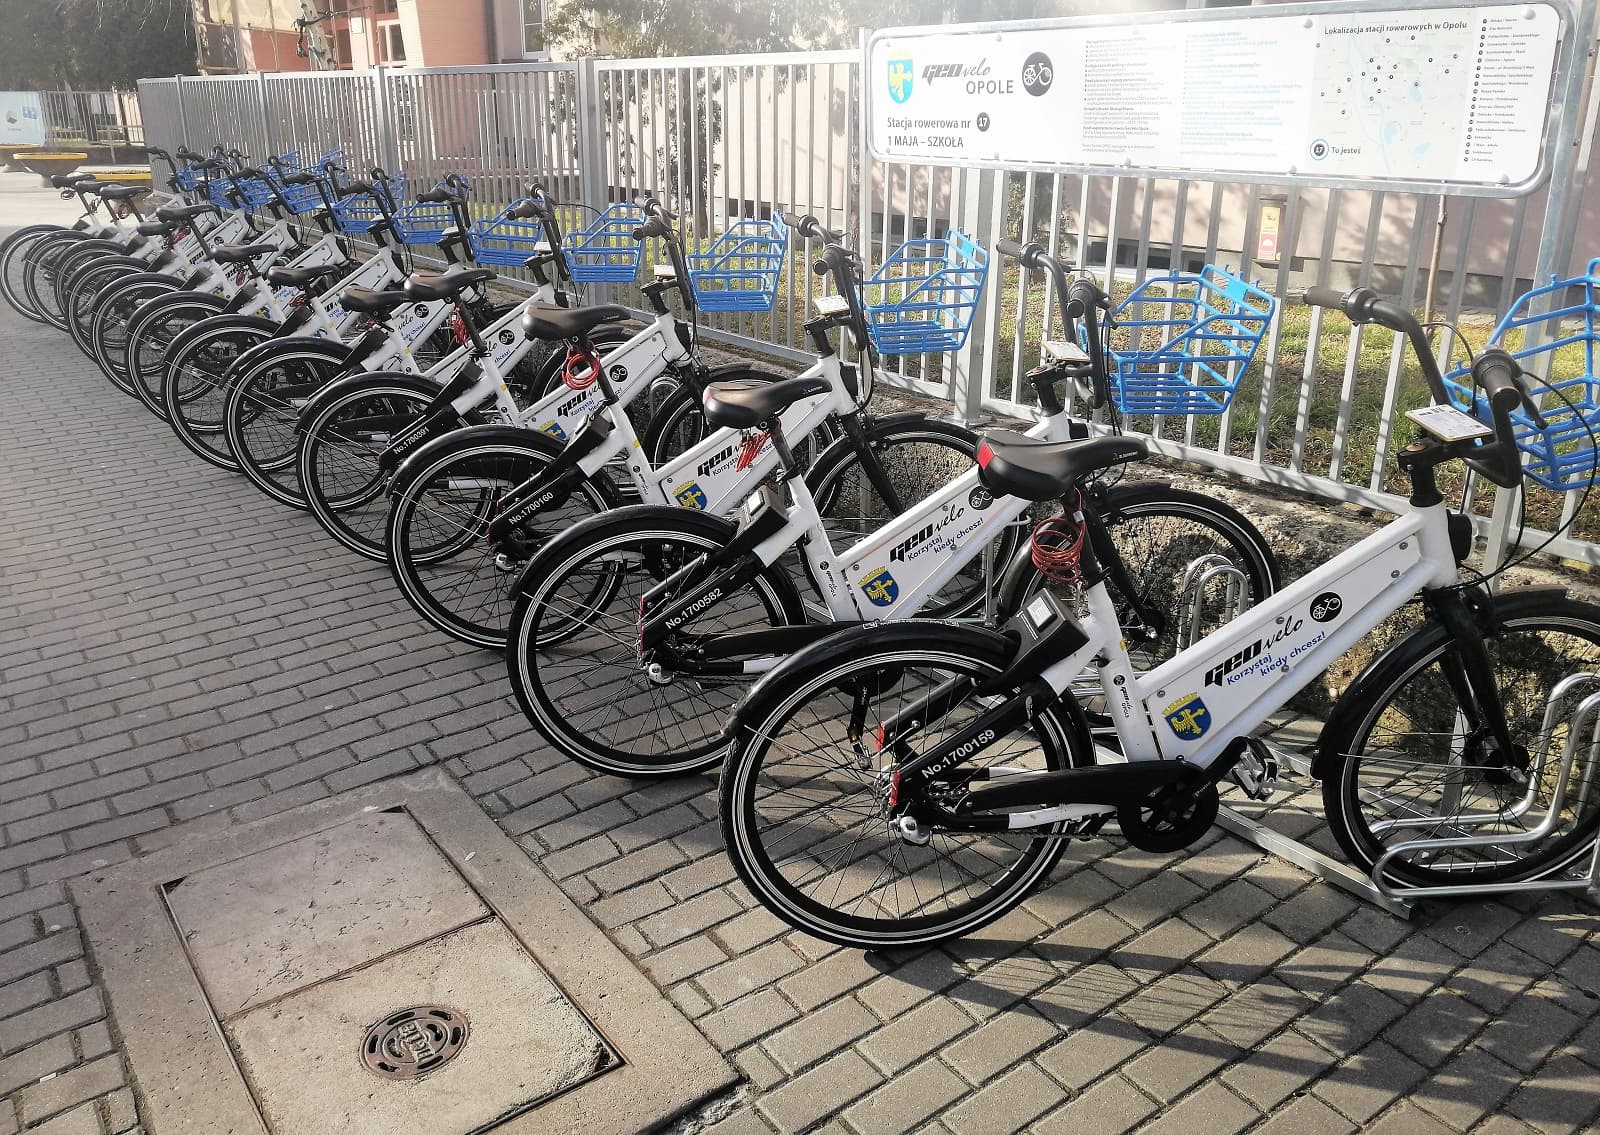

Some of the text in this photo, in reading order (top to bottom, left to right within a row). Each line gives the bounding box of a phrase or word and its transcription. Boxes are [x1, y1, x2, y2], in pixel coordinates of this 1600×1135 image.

[1324, 25, 1364, 35] Lokalizacja
[1365, 24, 1385, 34] stacji
[1386, 22, 1432, 32] rowerowych
[1443, 20, 1468, 31] Opolu
[965, 79, 1014, 95] OPOLE
[887, 116, 913, 131] Stacja
[914, 119, 959, 129] rowerowa
[960, 119, 971, 129] nr
[894, 135, 919, 147] MAJA
[927, 136, 964, 148] SZKOŁA
[1332, 146, 1340, 154] Tu
[508, 491, 554, 525] No.1700160
[907, 535, 943, 561] Korzystaj
[933, 517, 985, 554] kiedy chcesz!
[664, 587, 724, 629] No.1700582
[1226, 652, 1273, 686] Korzystaj
[1260, 631, 1326, 677] kiedy chcesz!
[921, 729, 995, 778] No.1700159
